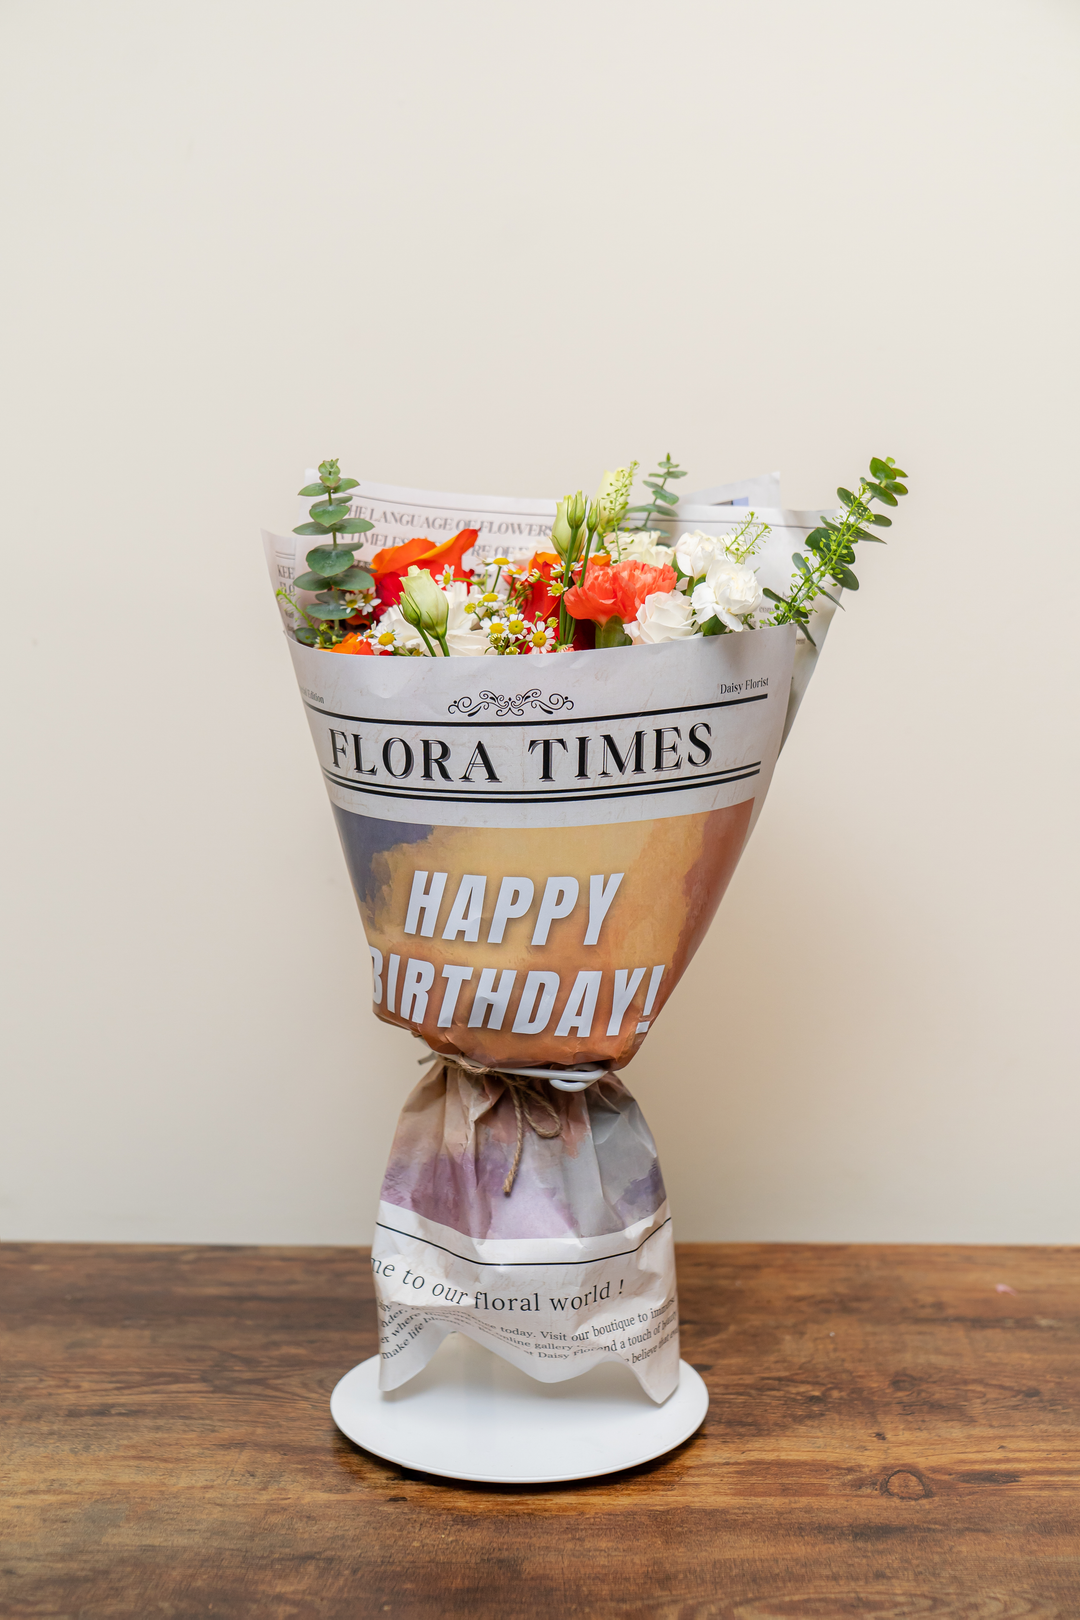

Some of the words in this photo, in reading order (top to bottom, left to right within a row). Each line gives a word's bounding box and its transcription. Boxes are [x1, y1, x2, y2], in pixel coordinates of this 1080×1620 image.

[347, 504, 368, 519] HE
[369, 508, 454, 532] LANGUAGE
[455, 519, 478, 533] OF
[720, 682, 743, 694] Daisy
[745, 677, 769, 690] Florist
[328, 728, 500, 783] FLORA
[527, 722, 712, 783] TIMES
[404, 870, 625, 946] HAPPY
[369, 945, 666, 1038] BIRTHDAY!
[402, 1269, 425, 1290] to
[432, 1283, 468, 1305] our
[473, 1291, 540, 1312] floral
[549, 1281, 611, 1312] world
[381, 1338, 410, 1360] make
[407, 1322, 425, 1340] life
[500, 1326, 537, 1339] today.
[540, 1330, 568, 1342] Visit
[571, 1331, 590, 1342] our
[591, 1316, 636, 1338] boutique
[637, 1313, 649, 1323] to
[620, 1340, 627, 1350] a
[627, 1329, 653, 1348] touch
[653, 1321, 662, 1337] of
[534, 1341, 574, 1352] gallery
[537, 1351, 571, 1360] Daisy
[631, 1344, 659, 1364] believe
